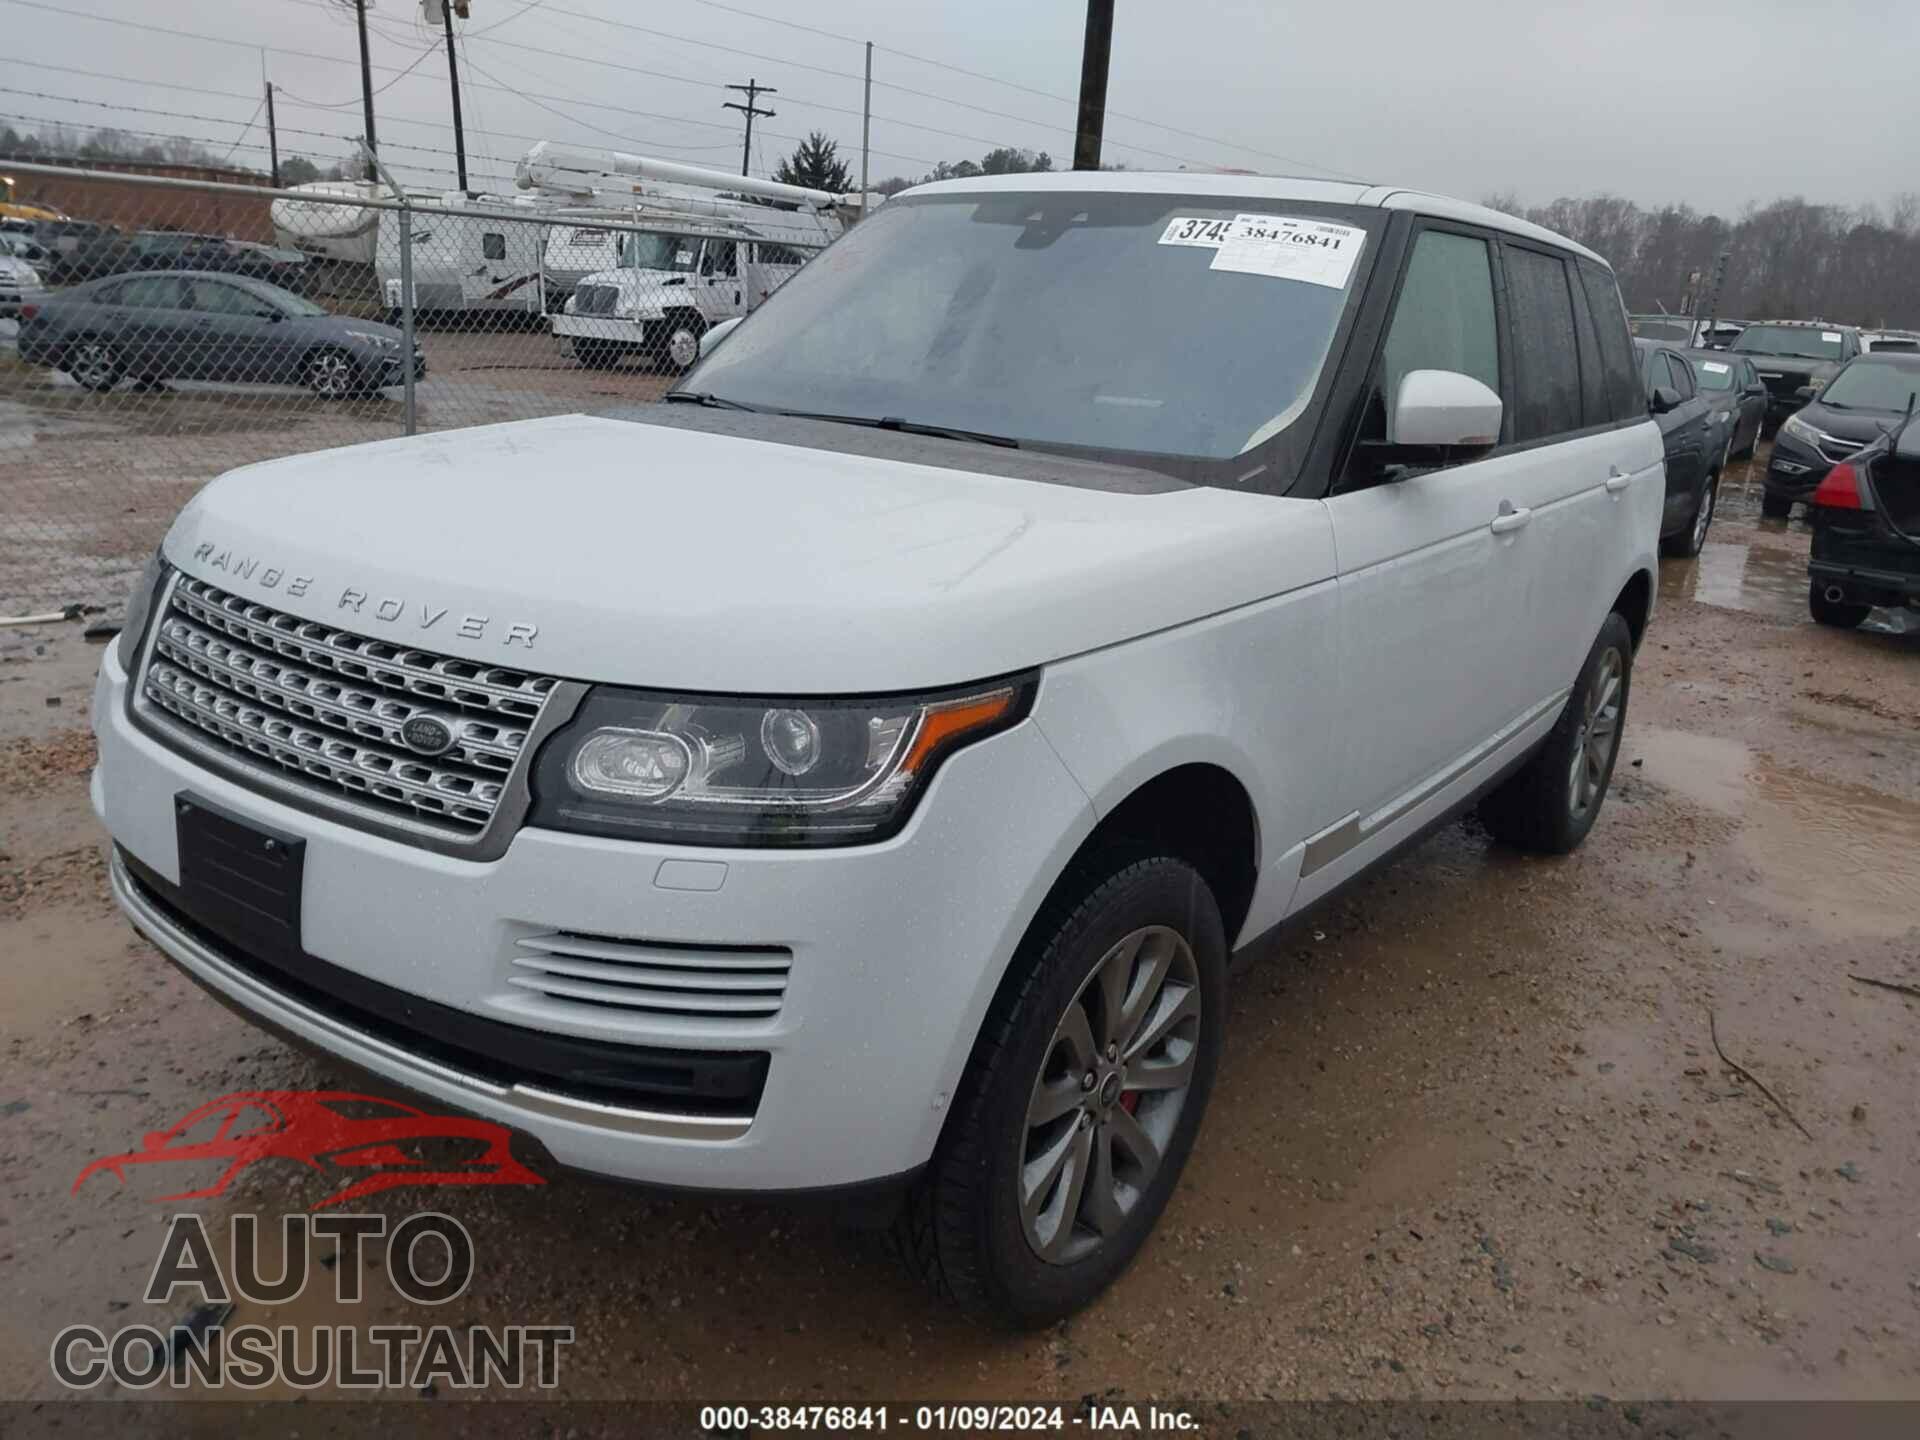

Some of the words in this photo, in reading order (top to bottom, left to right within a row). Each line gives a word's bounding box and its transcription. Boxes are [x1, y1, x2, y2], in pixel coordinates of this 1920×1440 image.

[1240, 226, 1341, 249] 38476841
[193, 542, 314, 598] RANGE
[338, 587, 539, 649] ROVER
